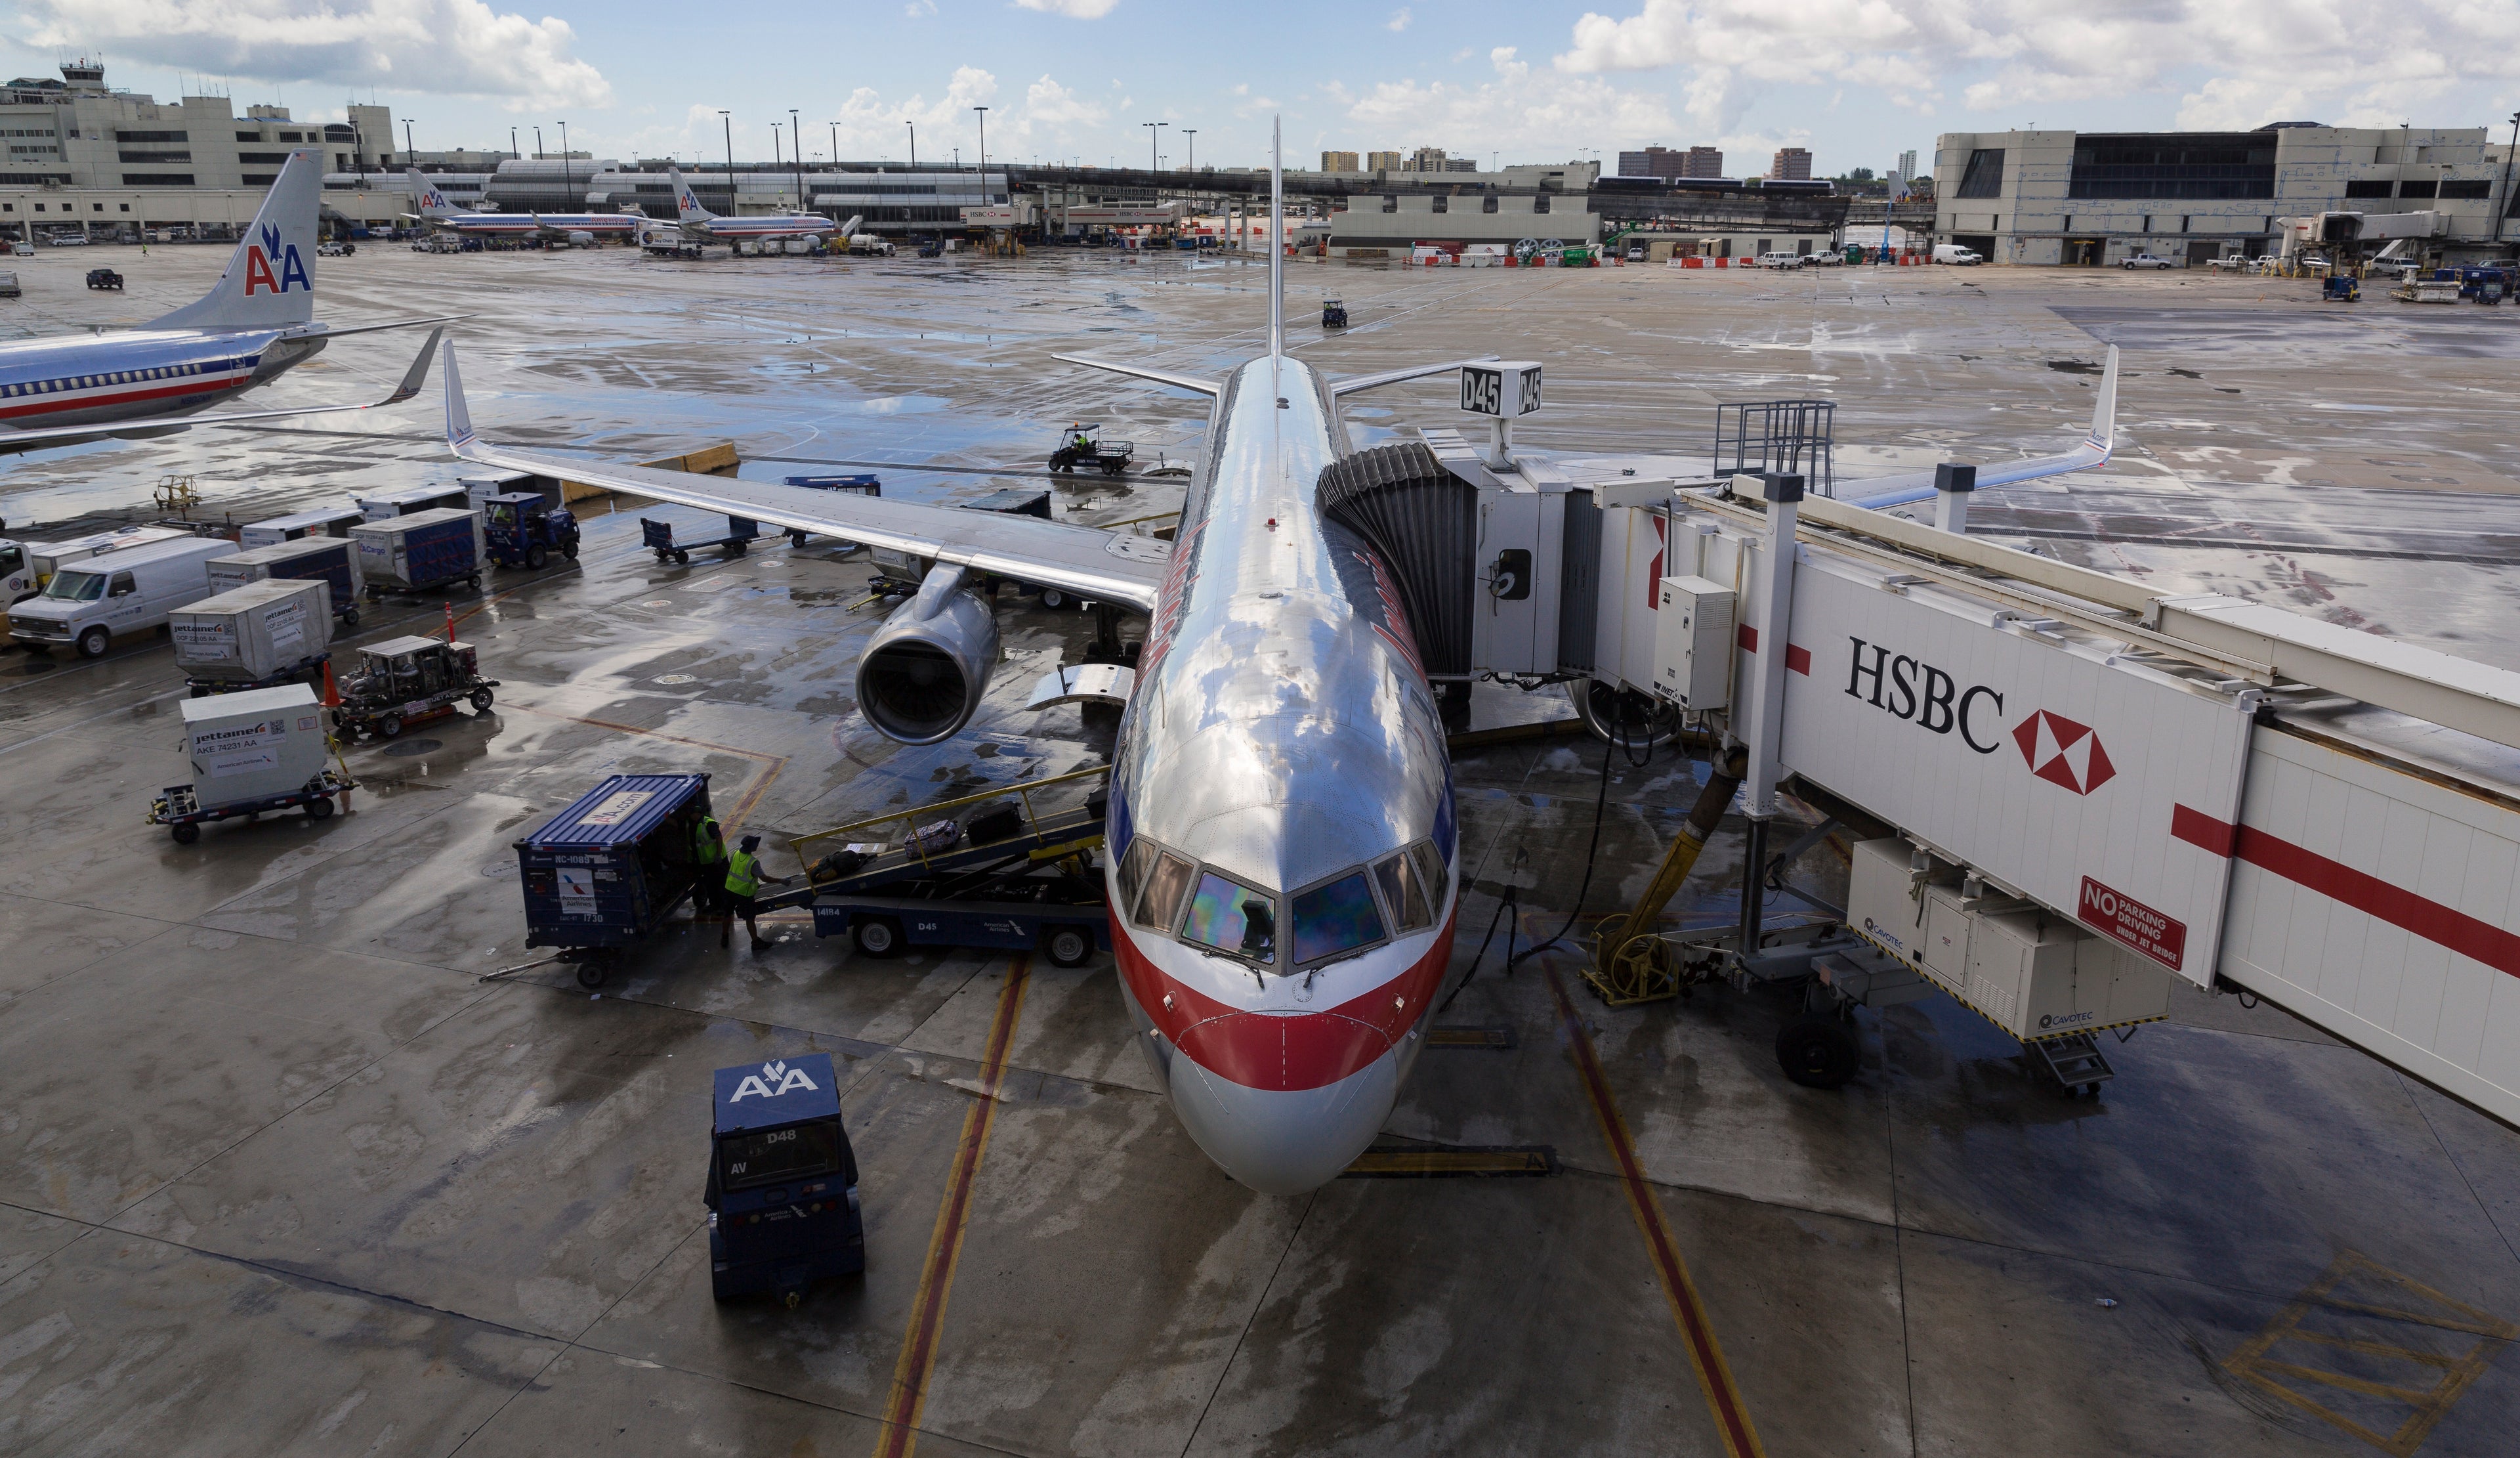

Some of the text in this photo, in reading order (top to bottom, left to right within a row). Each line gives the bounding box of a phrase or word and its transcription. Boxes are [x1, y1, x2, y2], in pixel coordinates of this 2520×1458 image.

[422, 194, 446, 208] AA
[680, 196, 698, 210] AA
[244, 243, 312, 297] AA
[1463, 372, 1499, 414] D45
[1519, 372, 1540, 414] D45
[265, 602, 297, 623] jettainer
[174, 624, 221, 633] jettainer
[1844, 635, 2003, 754] HSBC
[196, 723, 266, 744] jettainer
[197, 746, 215, 755] AKE
[218, 742, 241, 752] 74231
[594, 794, 643, 823] AA.com
[555, 855, 589, 864] NC-1089
[2084, 882, 2117, 916] NO
[584, 914, 602, 922] 1730
[2118, 911, 2161, 940] DRIVING
[2120, 899, 2166, 930] PARKING
[1874, 926, 1903, 950] CAVOTEC
[2116, 924, 2177, 962] UNDER JET BRIDGE
[2053, 1012, 2093, 1024] CAVOTEC
[730, 1069, 819, 1103] AA
[767, 1130, 797, 1144] D48
[731, 1162, 747, 1174] AV
